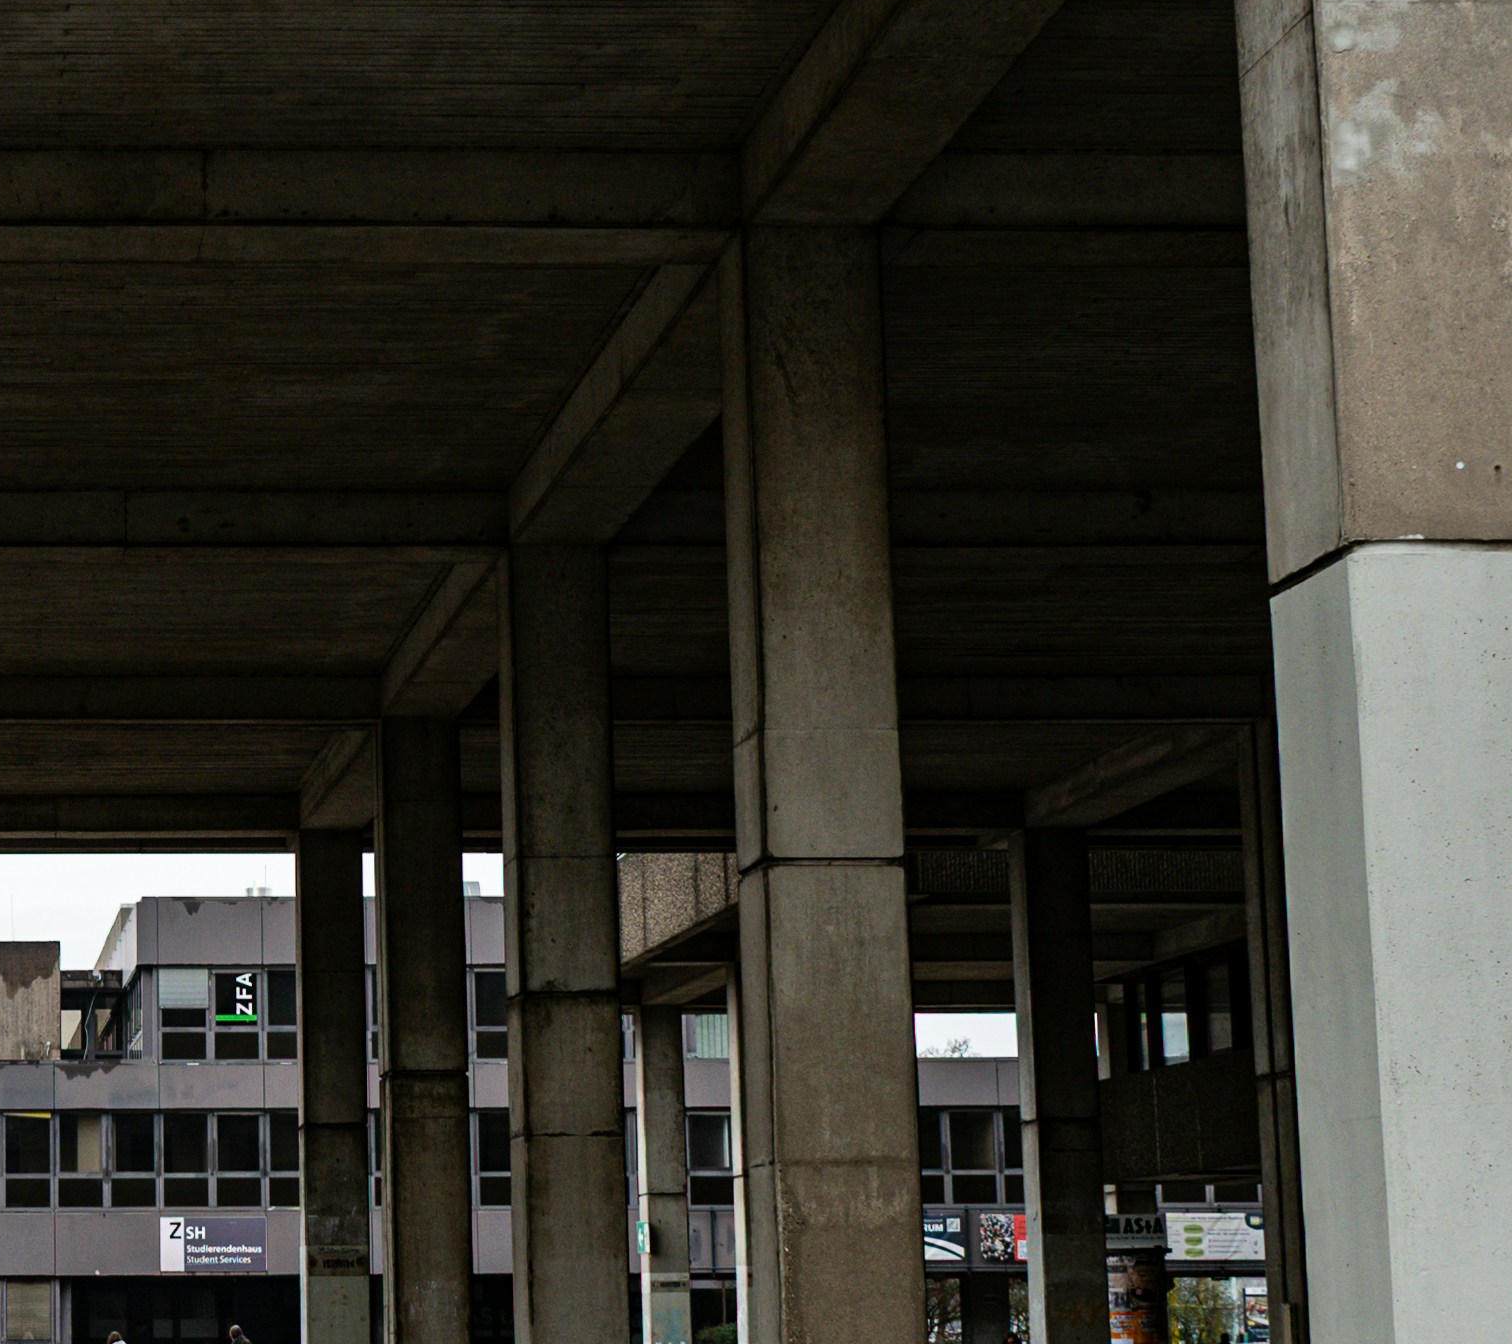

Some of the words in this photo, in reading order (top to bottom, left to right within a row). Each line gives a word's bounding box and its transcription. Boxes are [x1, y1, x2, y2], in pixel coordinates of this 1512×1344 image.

[235, 973, 253, 1016] ZFA
[169, 1222, 182, 1239] Z
[186, 1226, 206, 1240] SH
[1123, 1217, 1164, 1234] AStA
[186, 1245, 263, 1254] Studierendenhaus
[186, 1255, 218, 1264] Student
[220, 1255, 252, 1264] Services
